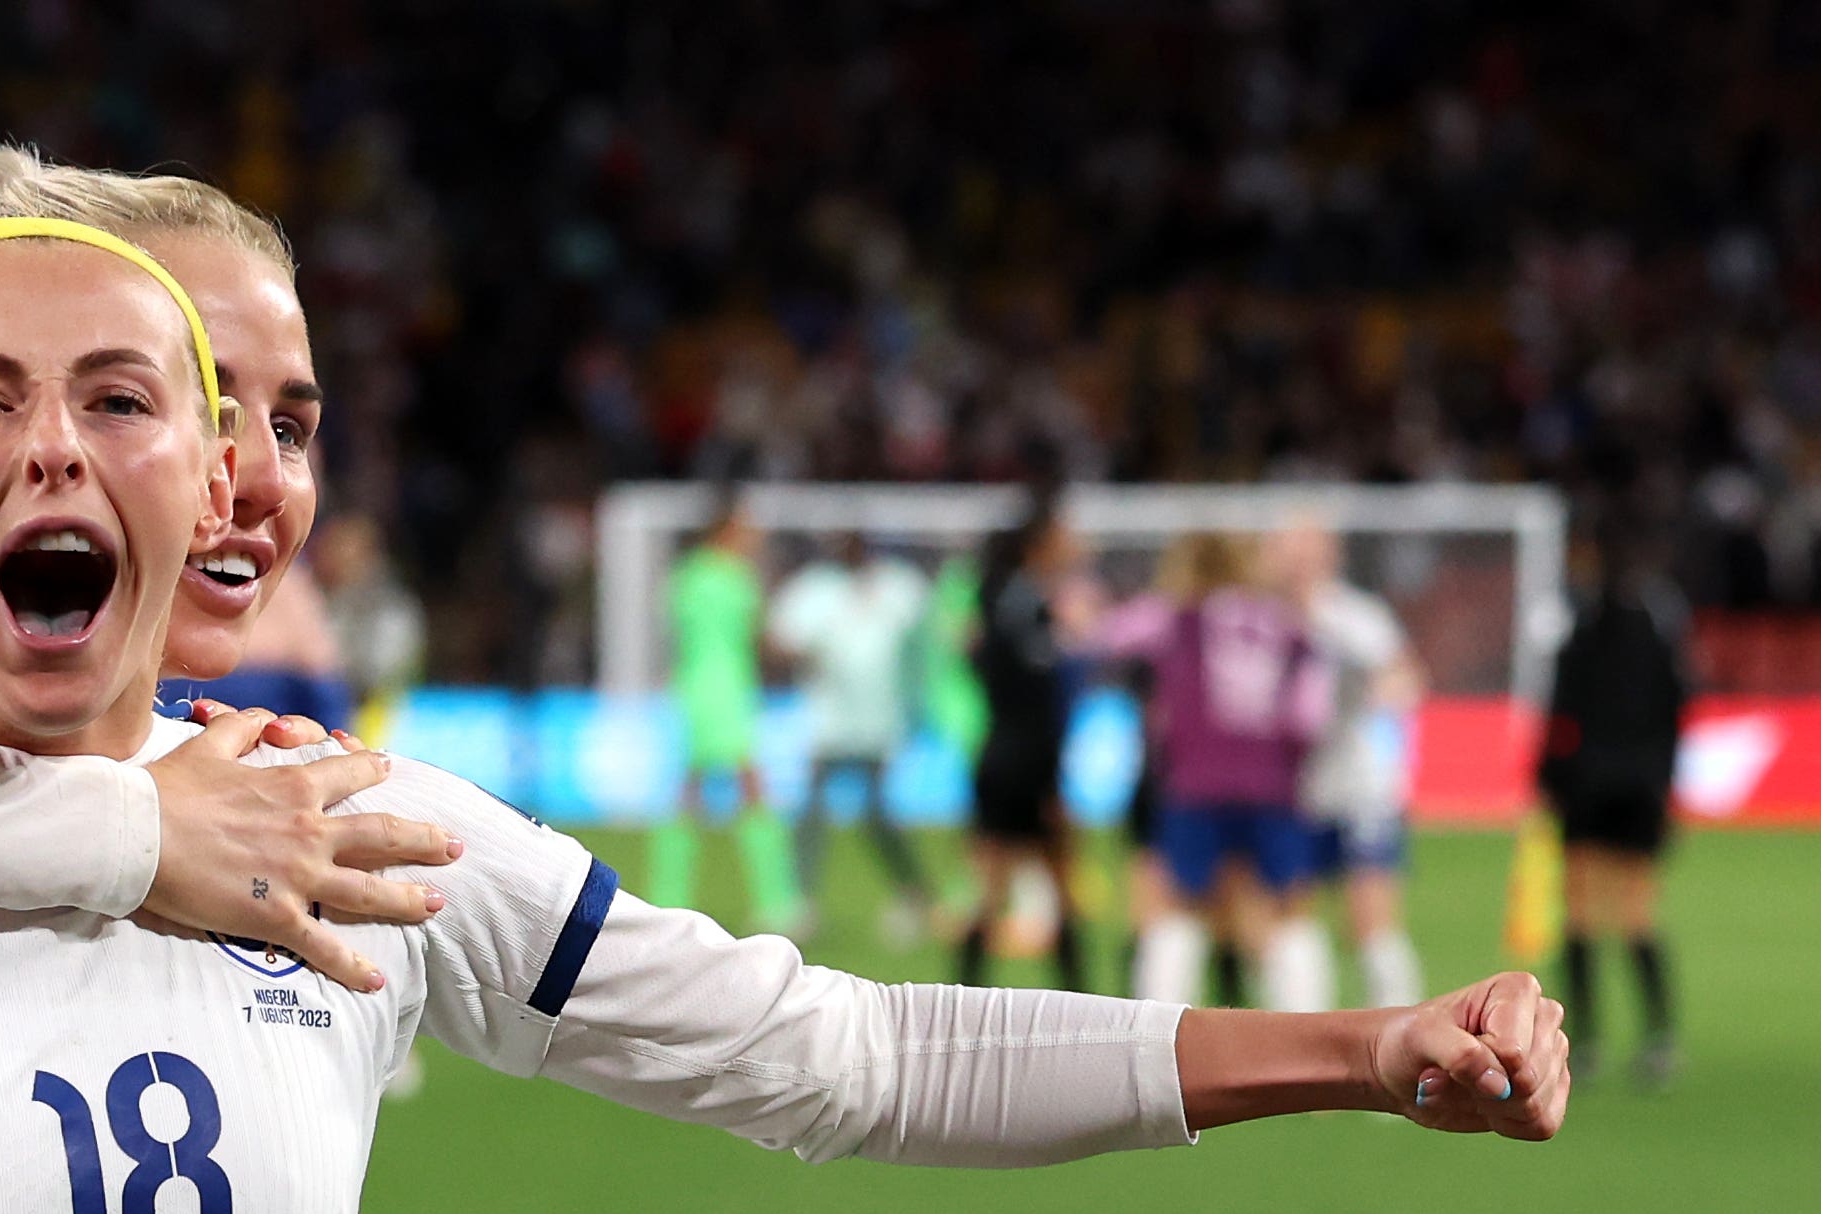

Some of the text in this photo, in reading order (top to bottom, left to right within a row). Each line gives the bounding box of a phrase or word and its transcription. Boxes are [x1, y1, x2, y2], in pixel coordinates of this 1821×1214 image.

[253, 989, 299, 1006] NIGERIA
[242, 1006, 331, 1028] 7 UGUST 2023
